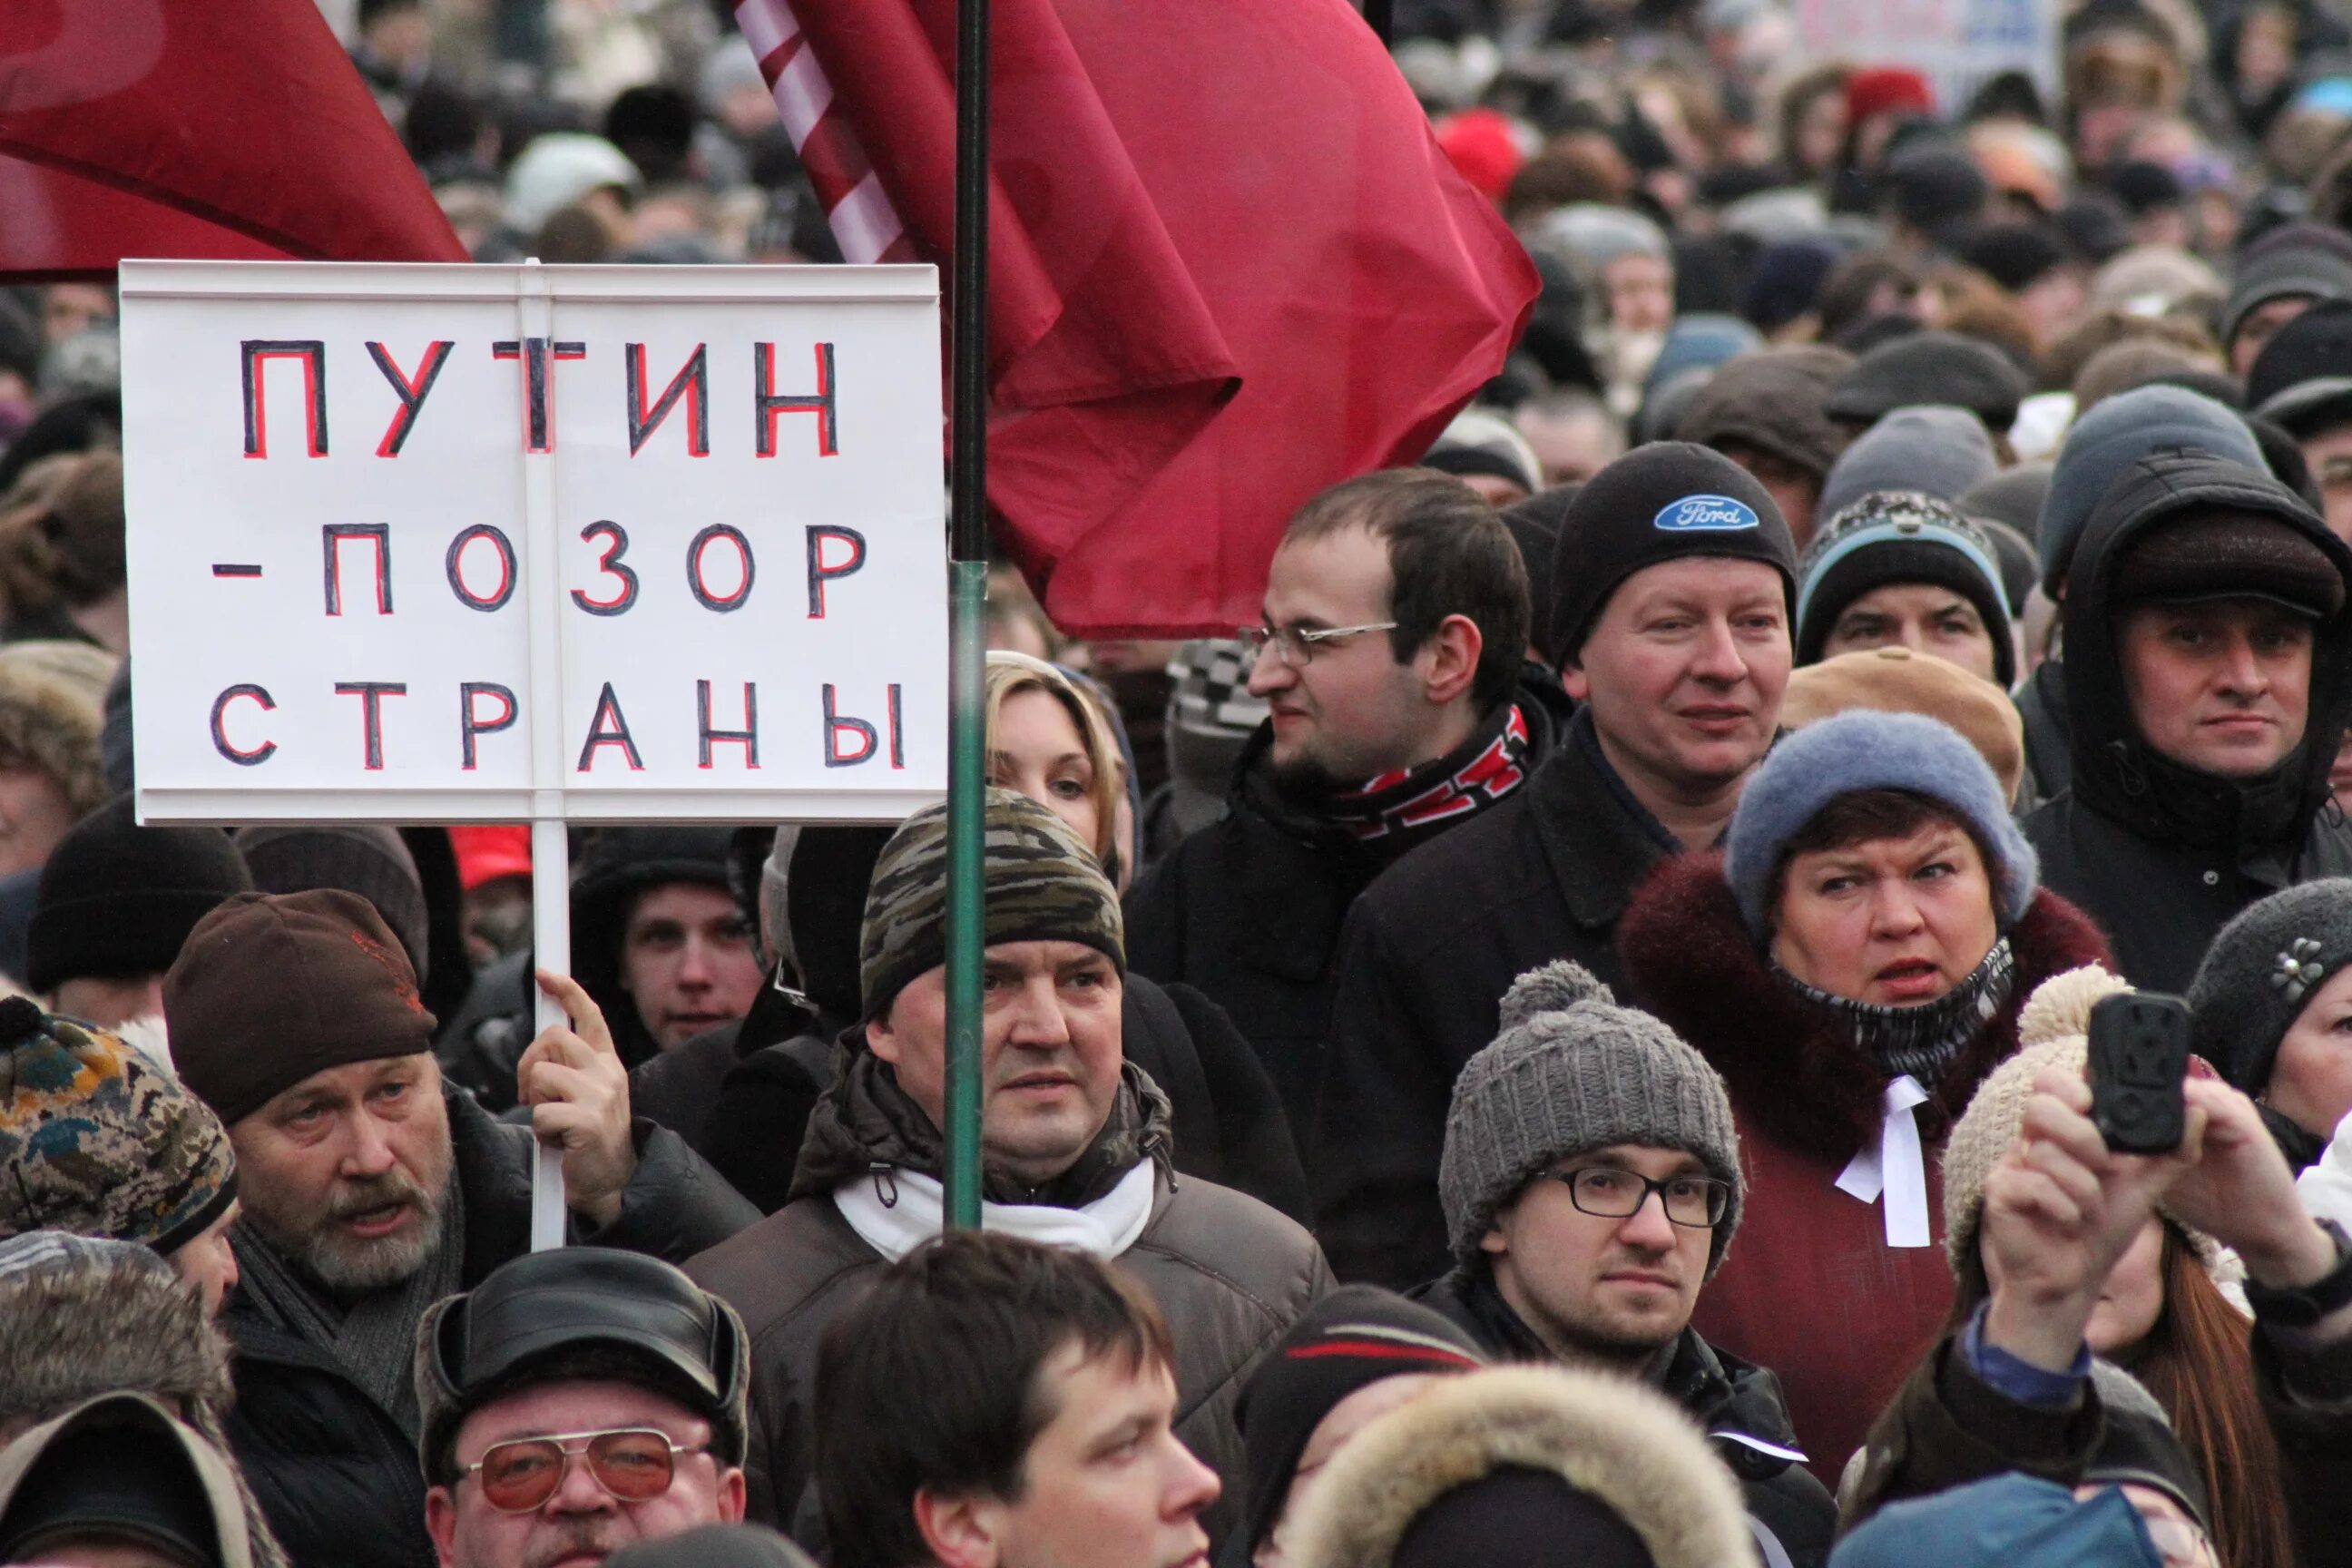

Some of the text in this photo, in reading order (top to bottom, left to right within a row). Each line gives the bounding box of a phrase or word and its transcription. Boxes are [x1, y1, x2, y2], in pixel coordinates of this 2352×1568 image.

[240, 338, 838, 460] ПУТИН
[1676, 500, 1741, 525] Ford
[210, 679, 906, 772] СТРАНЫ
